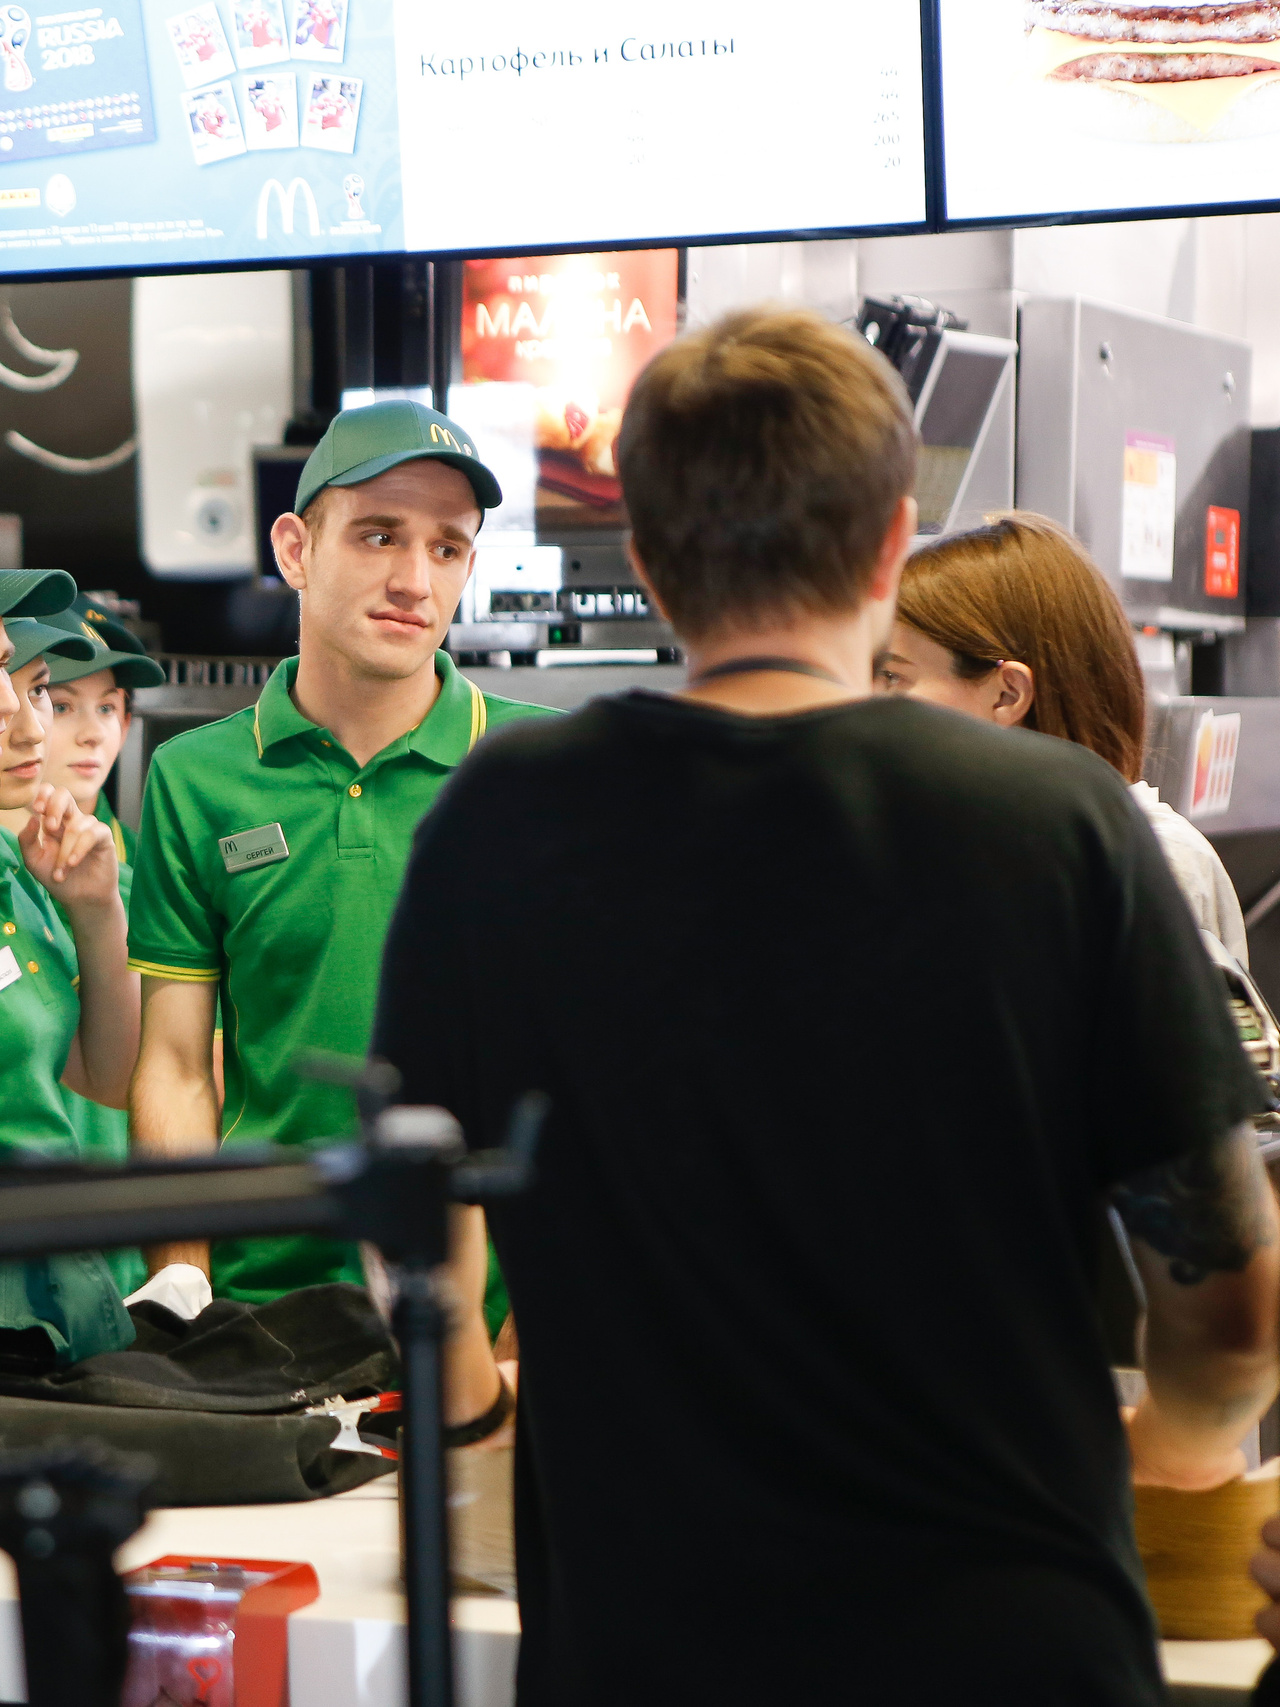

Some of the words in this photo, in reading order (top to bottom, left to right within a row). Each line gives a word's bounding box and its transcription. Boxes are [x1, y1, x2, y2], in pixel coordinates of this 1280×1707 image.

[37, 17, 125, 48] RUSSIA
[41, 43, 96, 71] 2018
[419, 45, 583, 81] Картофель
[593, 47, 609, 65] и
[619, 36, 736, 64] Салаты
[246, 846, 274, 860] СЕРГЕЙ
